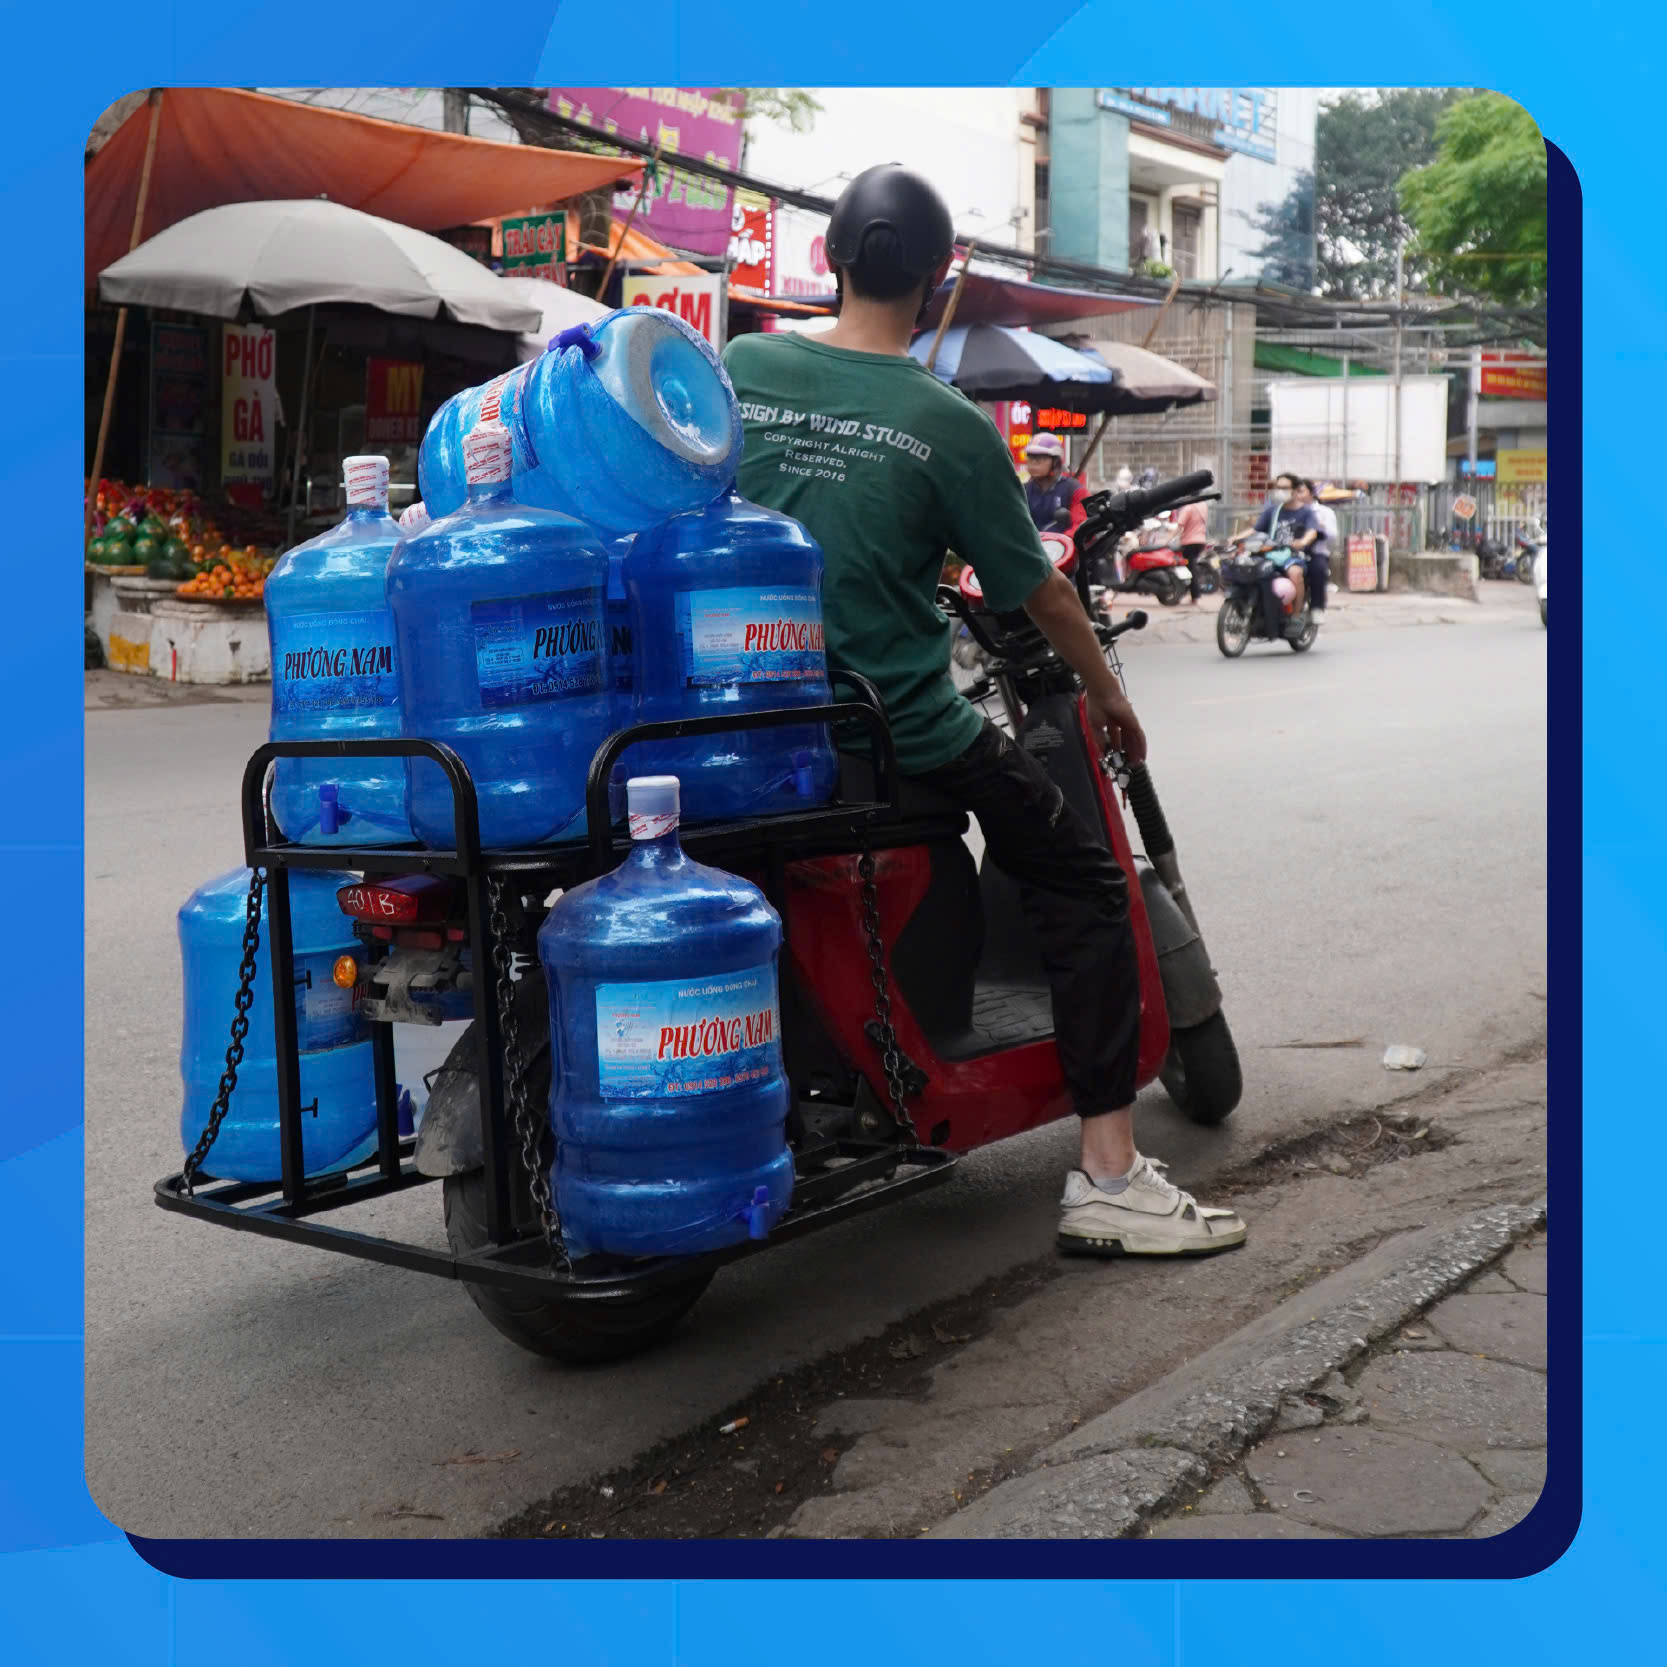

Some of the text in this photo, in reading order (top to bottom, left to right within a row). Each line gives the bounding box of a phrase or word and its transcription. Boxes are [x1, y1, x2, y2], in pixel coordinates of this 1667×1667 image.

[505, 221, 536, 257] TRÁI
[537, 217, 564, 253] CÂY
[225, 329, 272, 380] PHỞ
[233, 390, 265, 442] GÀ
[778, 462, 812, 478] SINCE
[831, 443, 887, 463] ALRIGHT
[533, 619, 598, 660] PHƯƠNG
[744, 617, 808, 653] PHƯƠNG
[283, 645, 393, 681] PHƯƠNG NAM
[657, 1014, 741, 1061] PHƯƠNG
[743, 1008, 773, 1049] NAM
